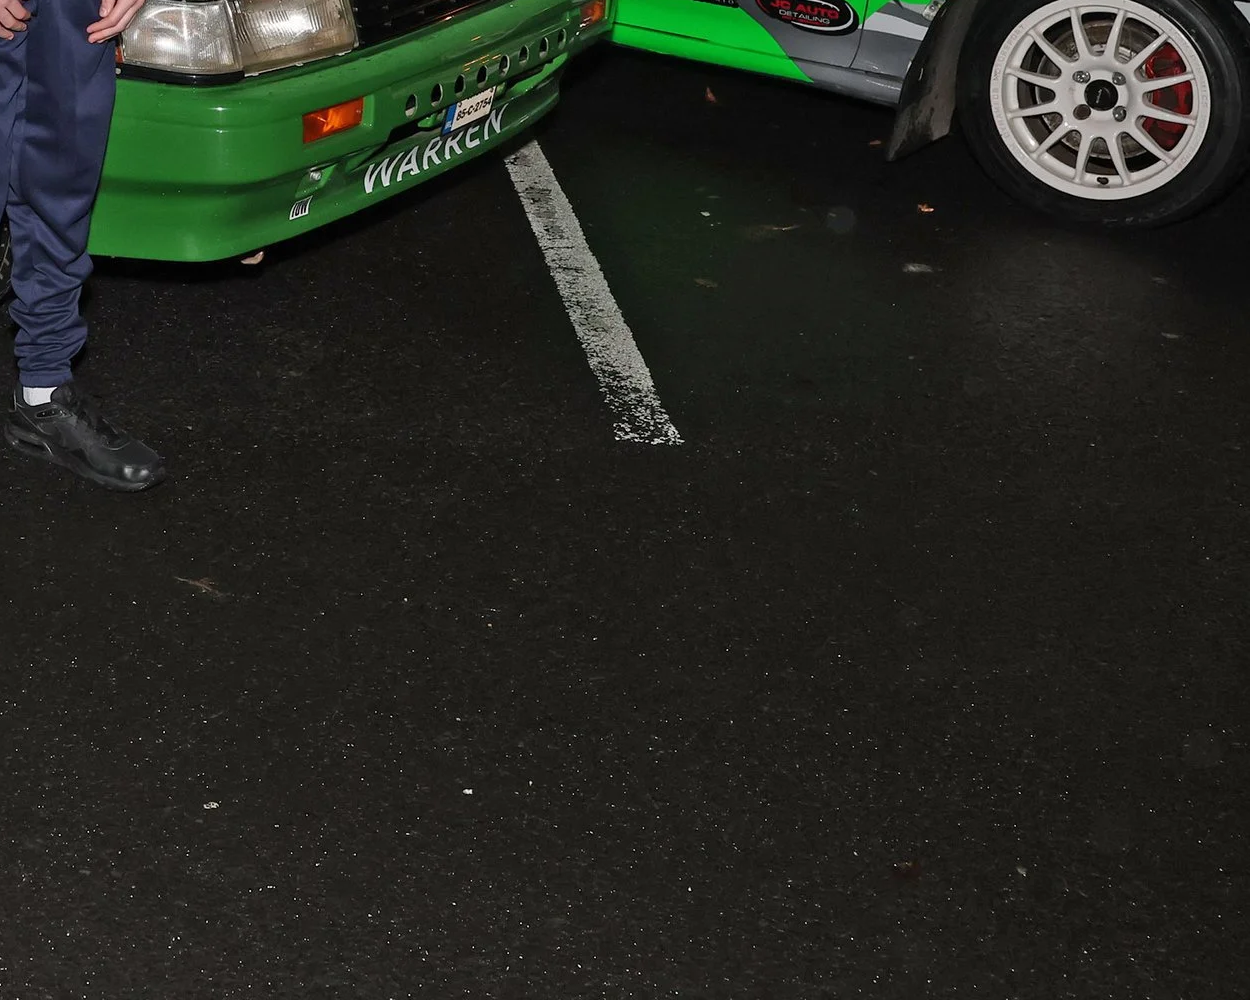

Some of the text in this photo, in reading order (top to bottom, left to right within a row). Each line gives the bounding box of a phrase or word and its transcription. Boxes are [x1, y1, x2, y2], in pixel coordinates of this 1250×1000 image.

[778, 9, 830, 25] DETAILING
[795, 3, 839, 20] AUTO
[364, 103, 509, 194] WARREN
